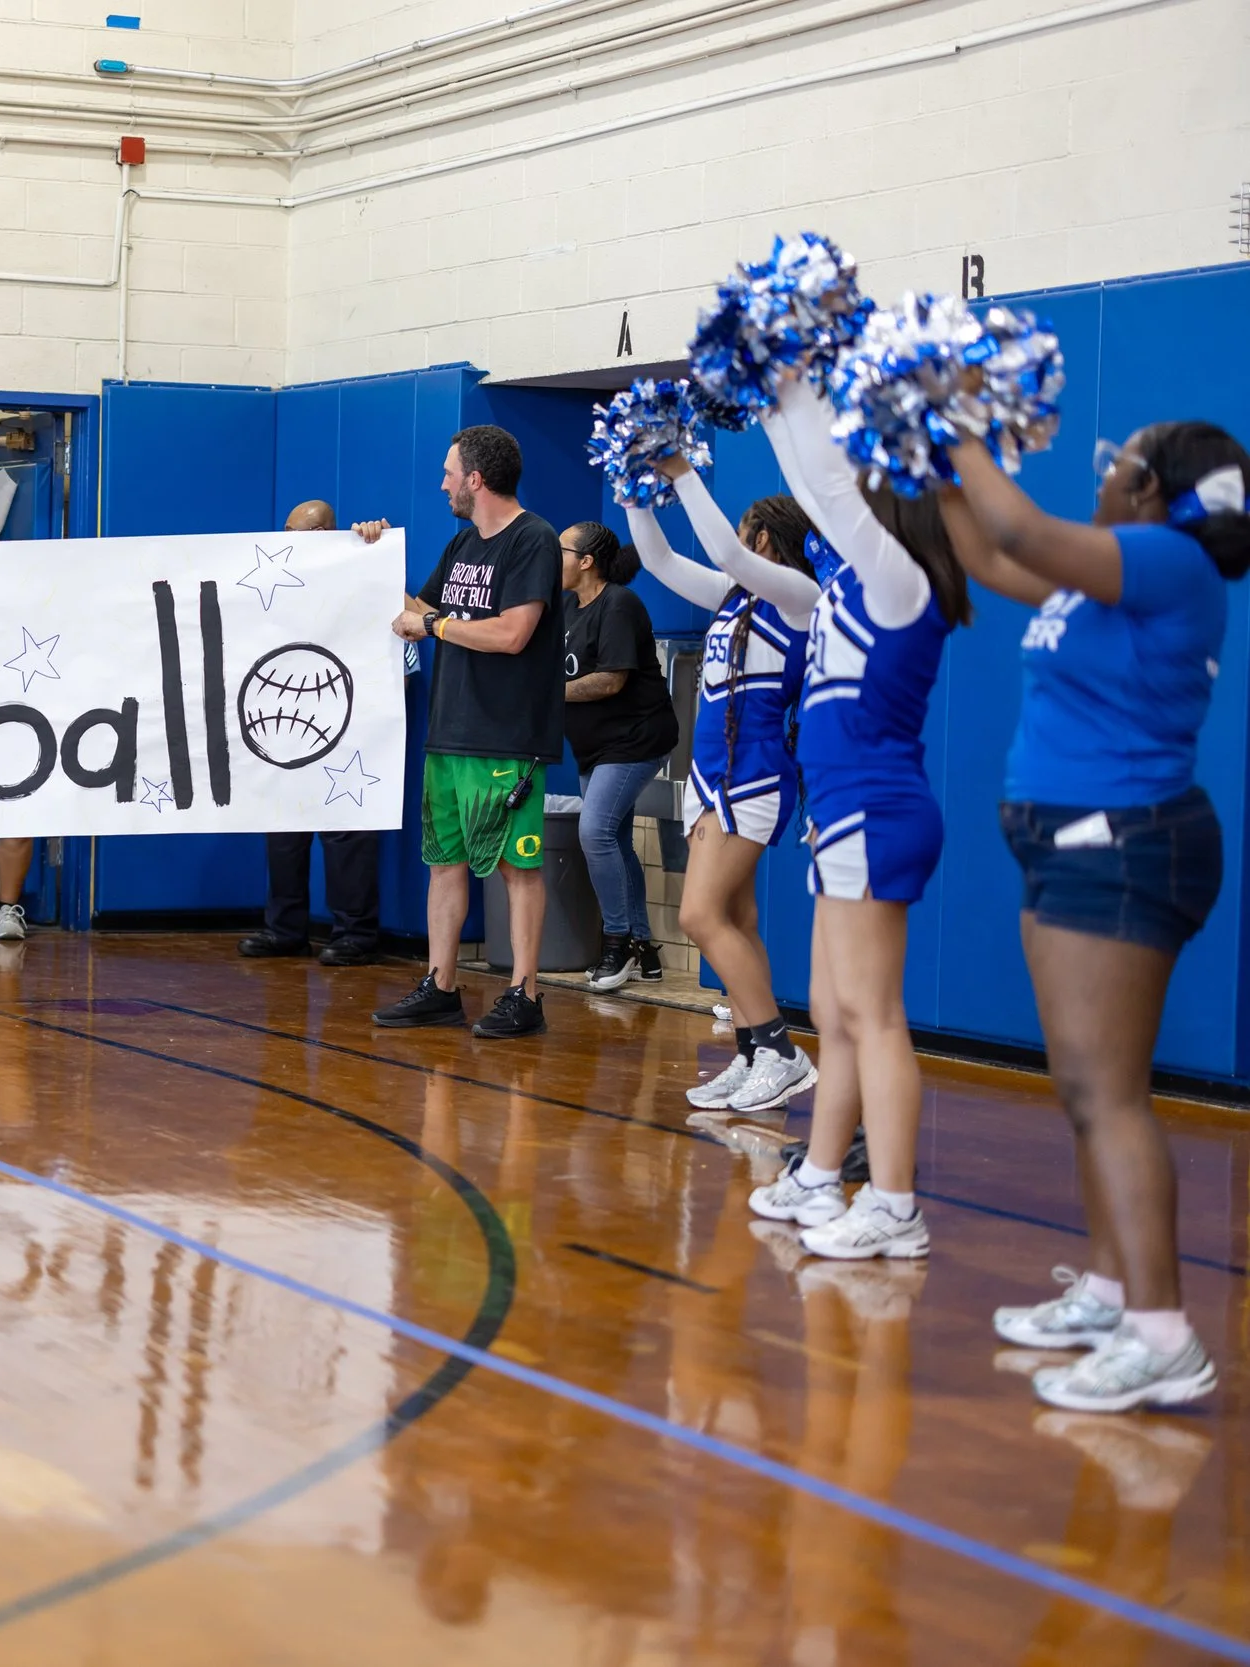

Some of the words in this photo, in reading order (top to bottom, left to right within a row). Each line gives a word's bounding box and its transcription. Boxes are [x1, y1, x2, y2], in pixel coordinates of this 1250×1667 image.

[617, 311, 633, 357] A
[449, 562, 495, 586] BROOKLYN
[441, 583, 492, 610] BASKEBALL
[516, 835, 541, 857] O
